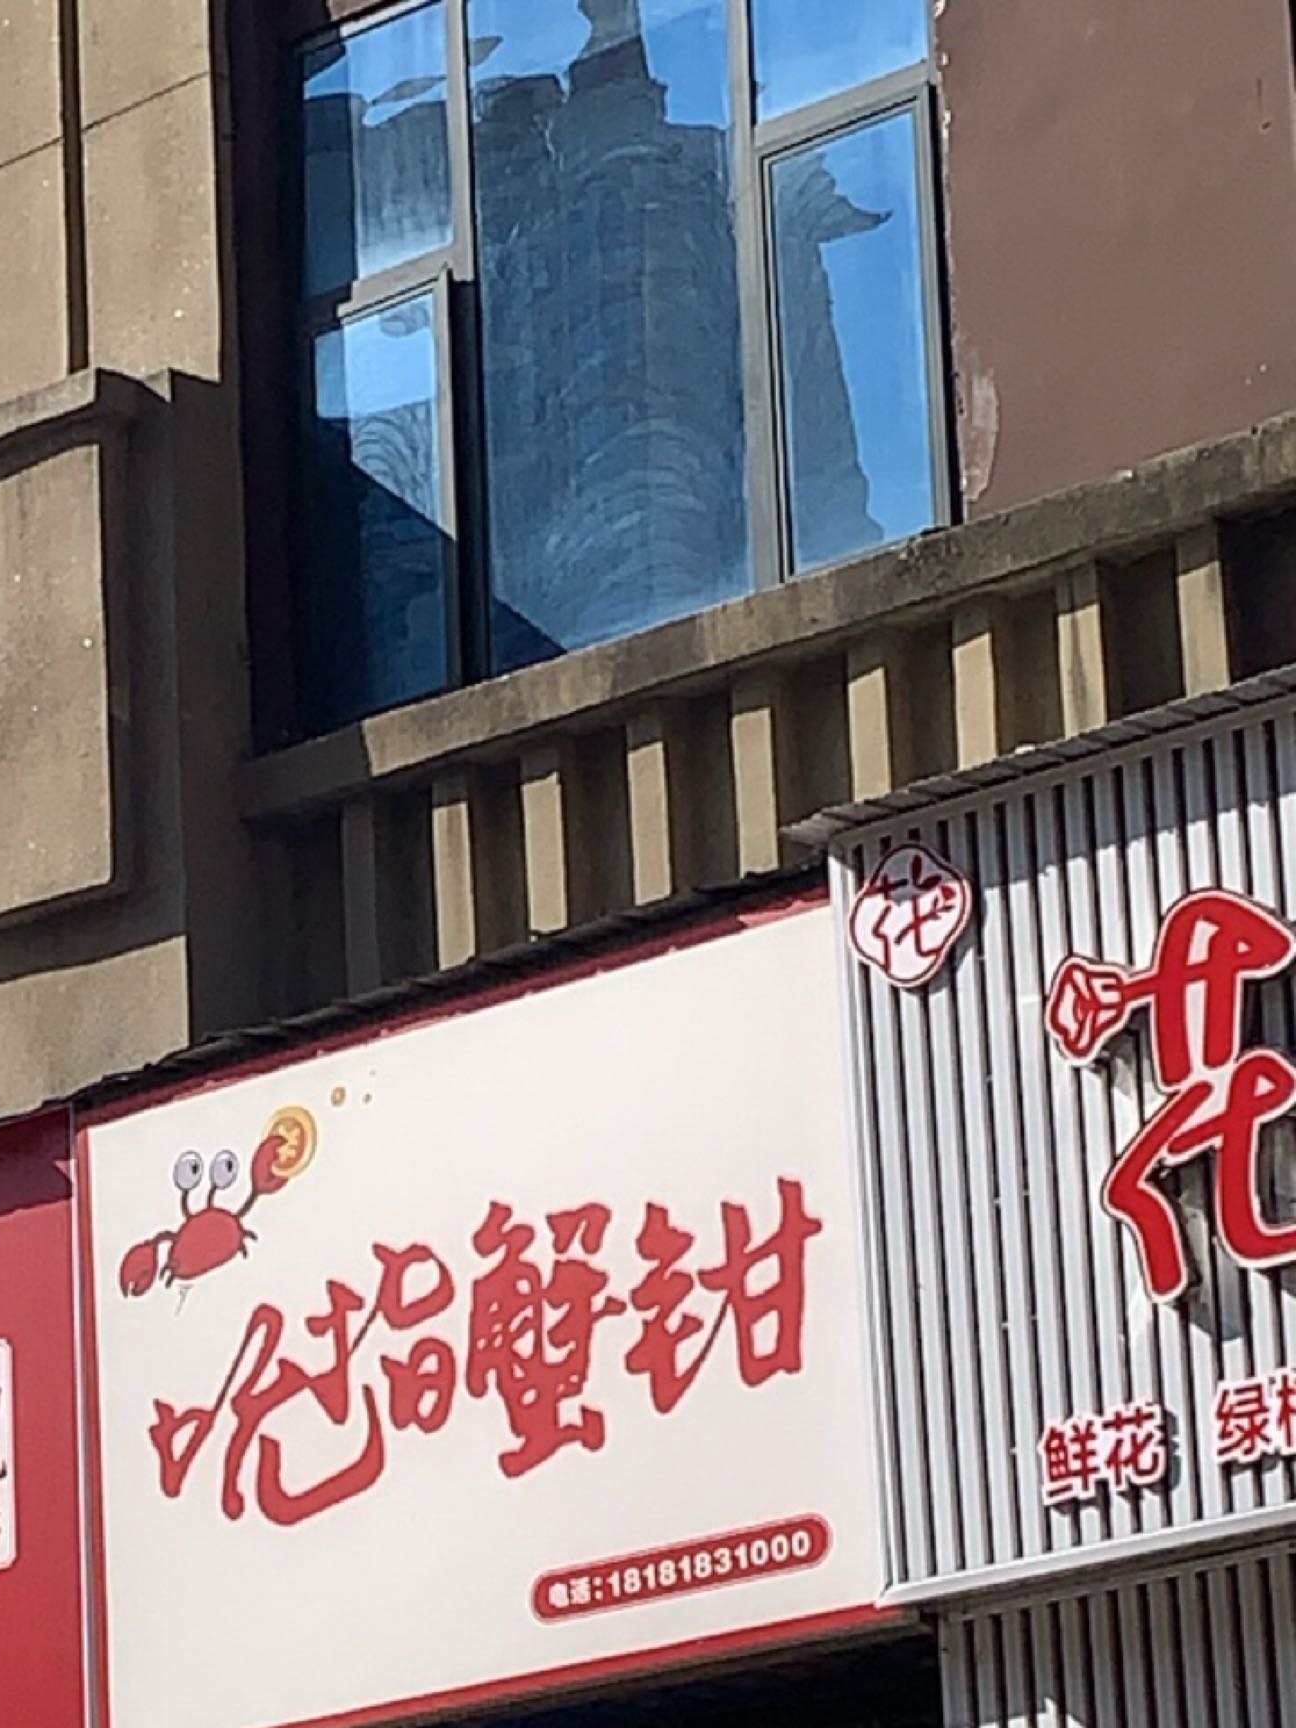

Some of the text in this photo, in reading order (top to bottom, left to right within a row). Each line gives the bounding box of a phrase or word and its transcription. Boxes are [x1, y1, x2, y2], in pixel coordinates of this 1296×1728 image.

[149, 1176, 824, 1527] 吮指蟹钳
[1044, 1404, 1164, 1500] 鲜花
